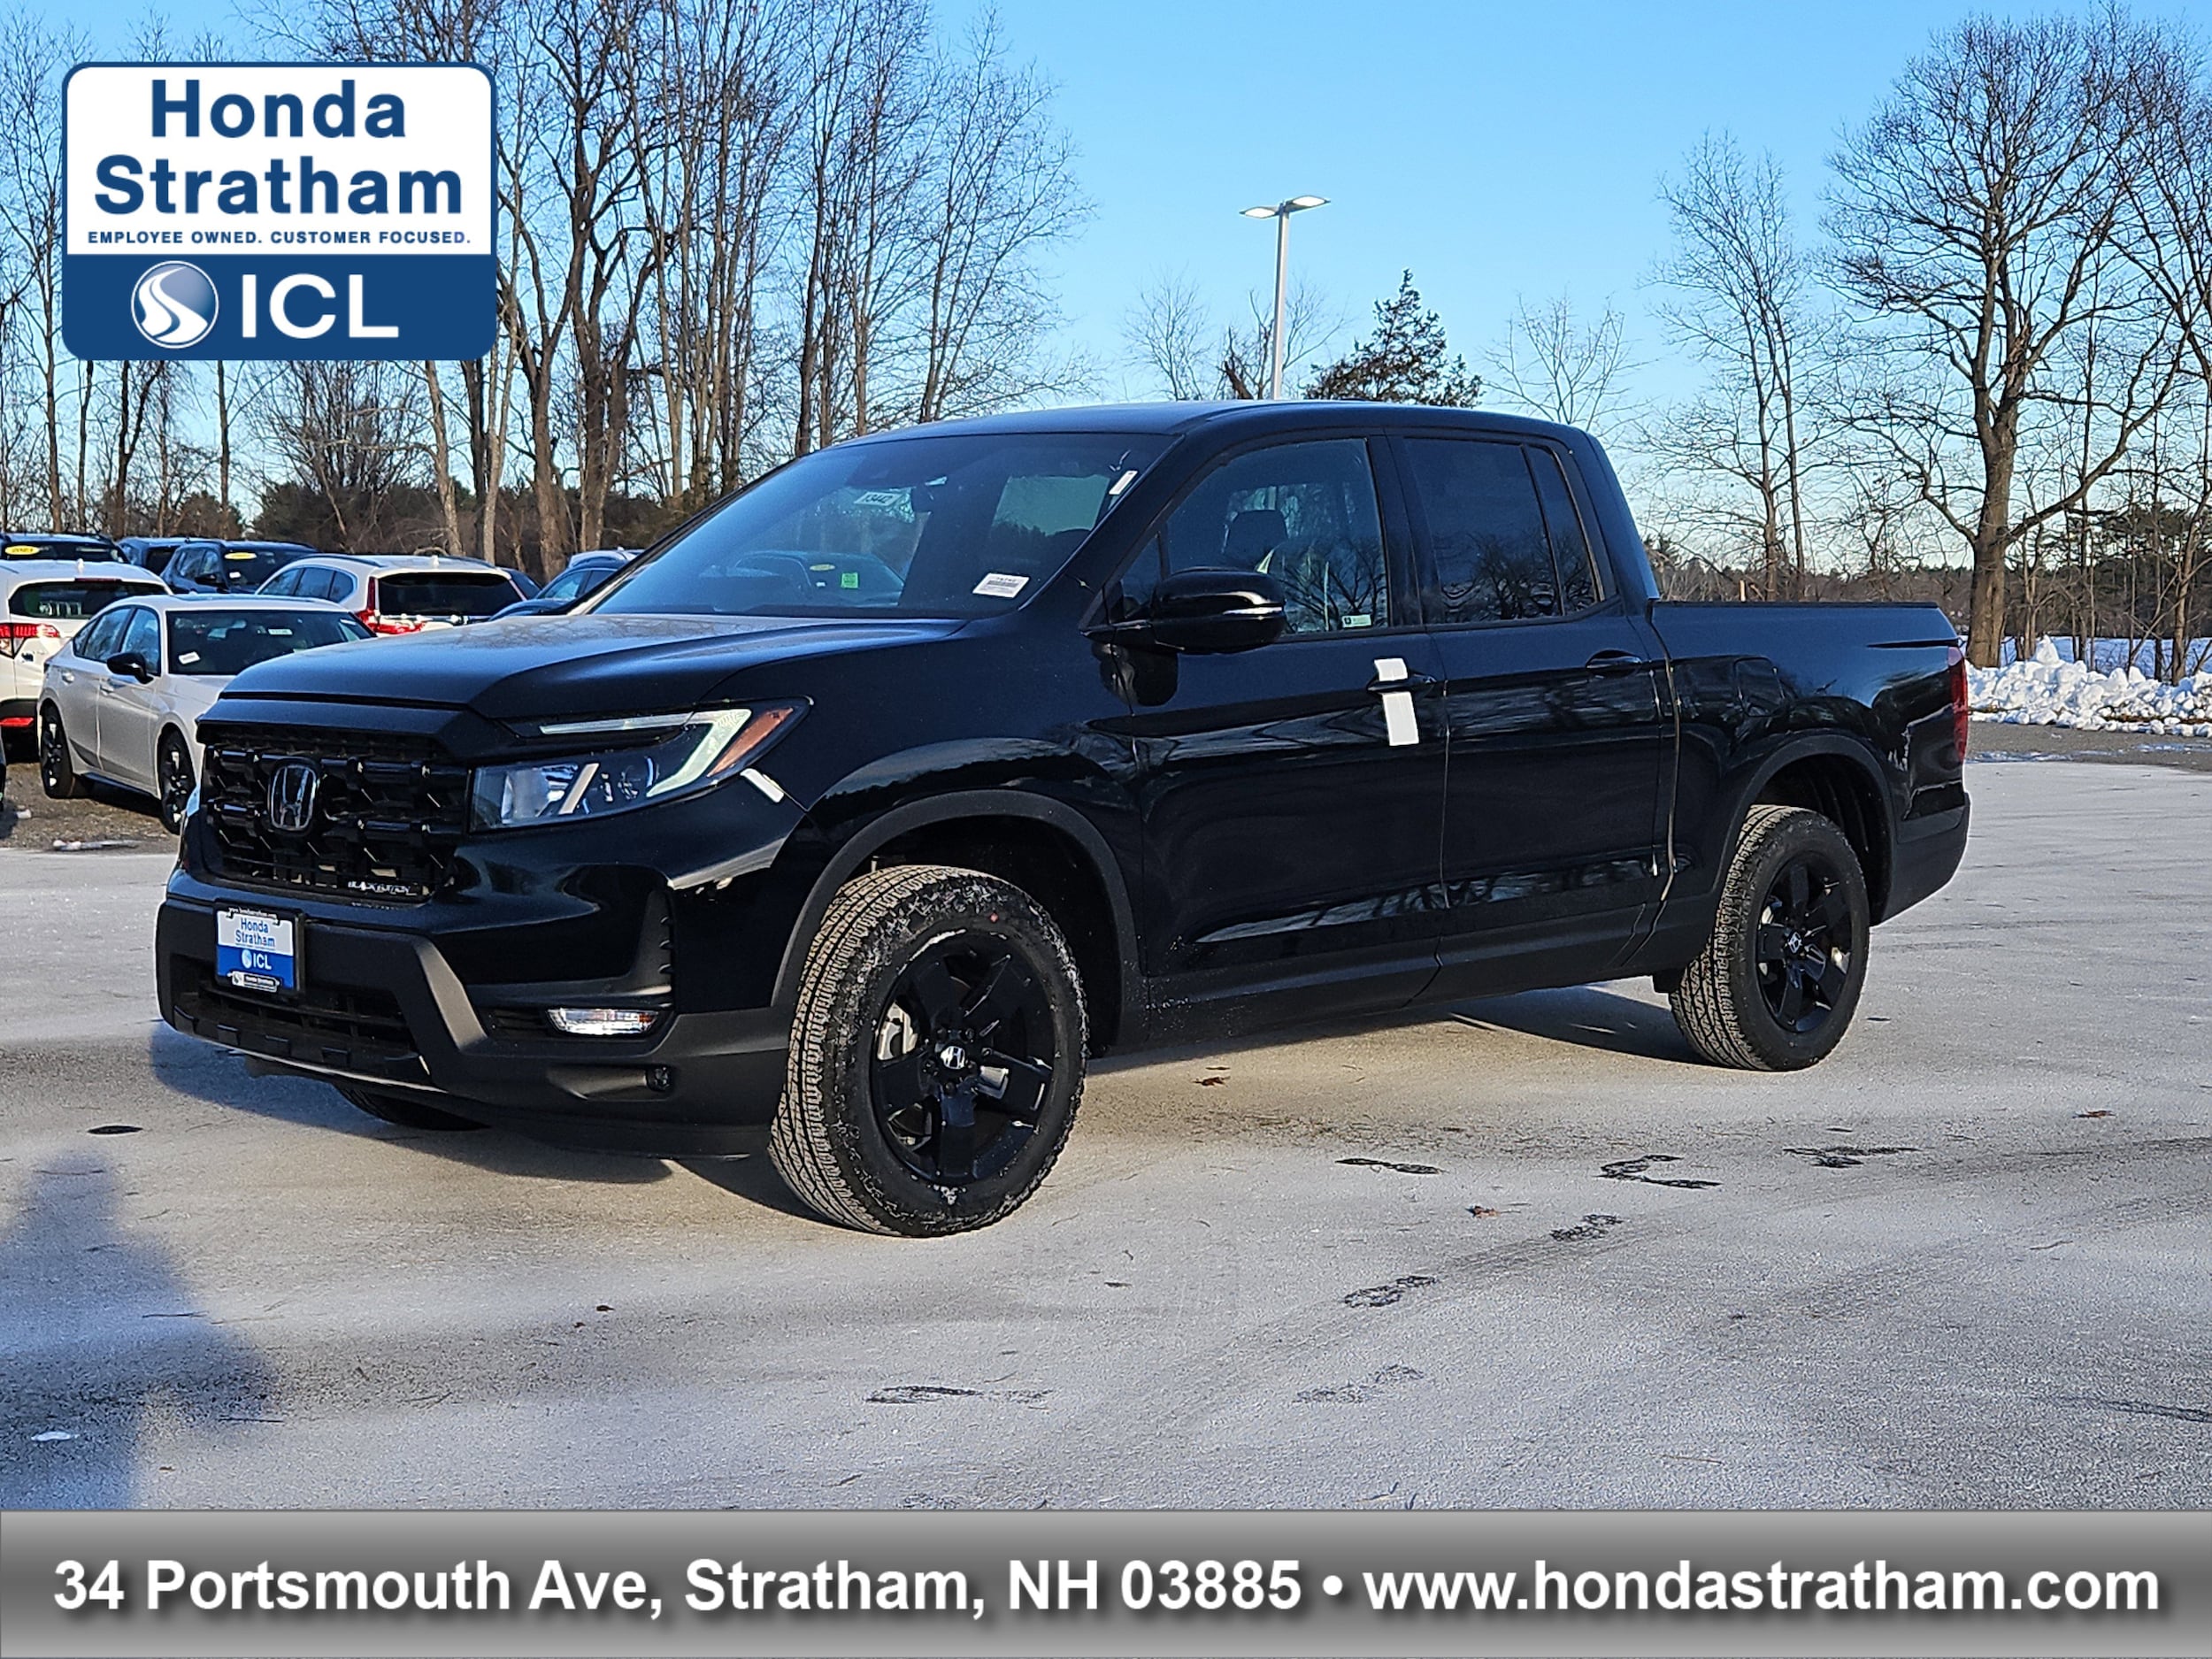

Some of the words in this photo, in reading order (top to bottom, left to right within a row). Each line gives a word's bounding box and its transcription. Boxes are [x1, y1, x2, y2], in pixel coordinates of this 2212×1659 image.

[240, 918, 269, 933] Honda
[235, 929, 275, 947] Stratham
[253, 953, 273, 970] ICL
